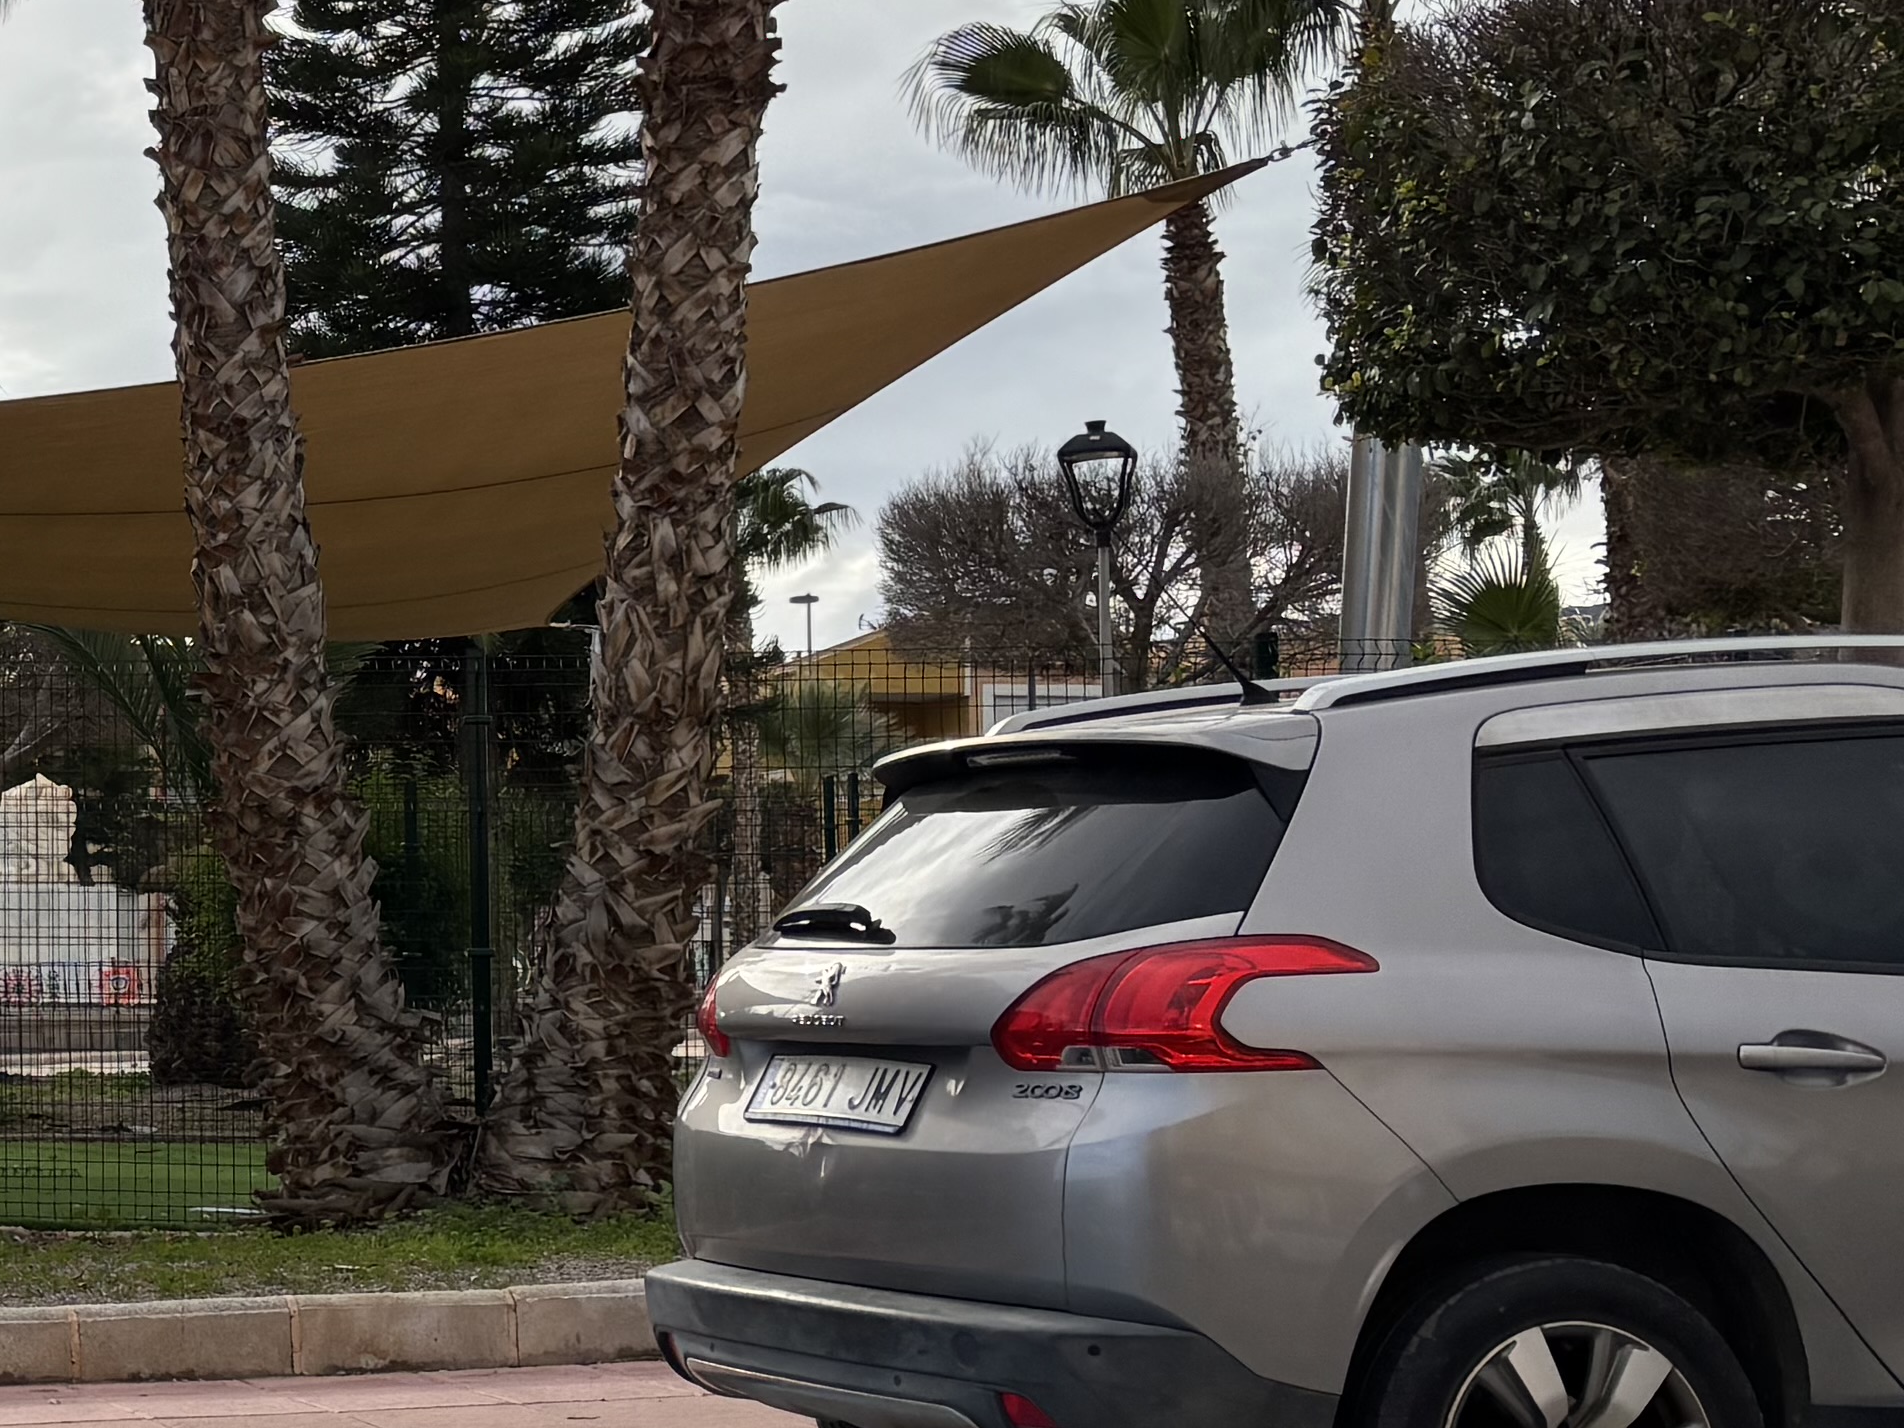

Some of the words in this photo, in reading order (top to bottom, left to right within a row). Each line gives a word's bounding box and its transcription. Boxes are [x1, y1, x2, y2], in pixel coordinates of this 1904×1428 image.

[770, 1062, 847, 1108] 8461
[848, 1066, 923, 1116] JMV
[1012, 1083, 1083, 1100] 2008
